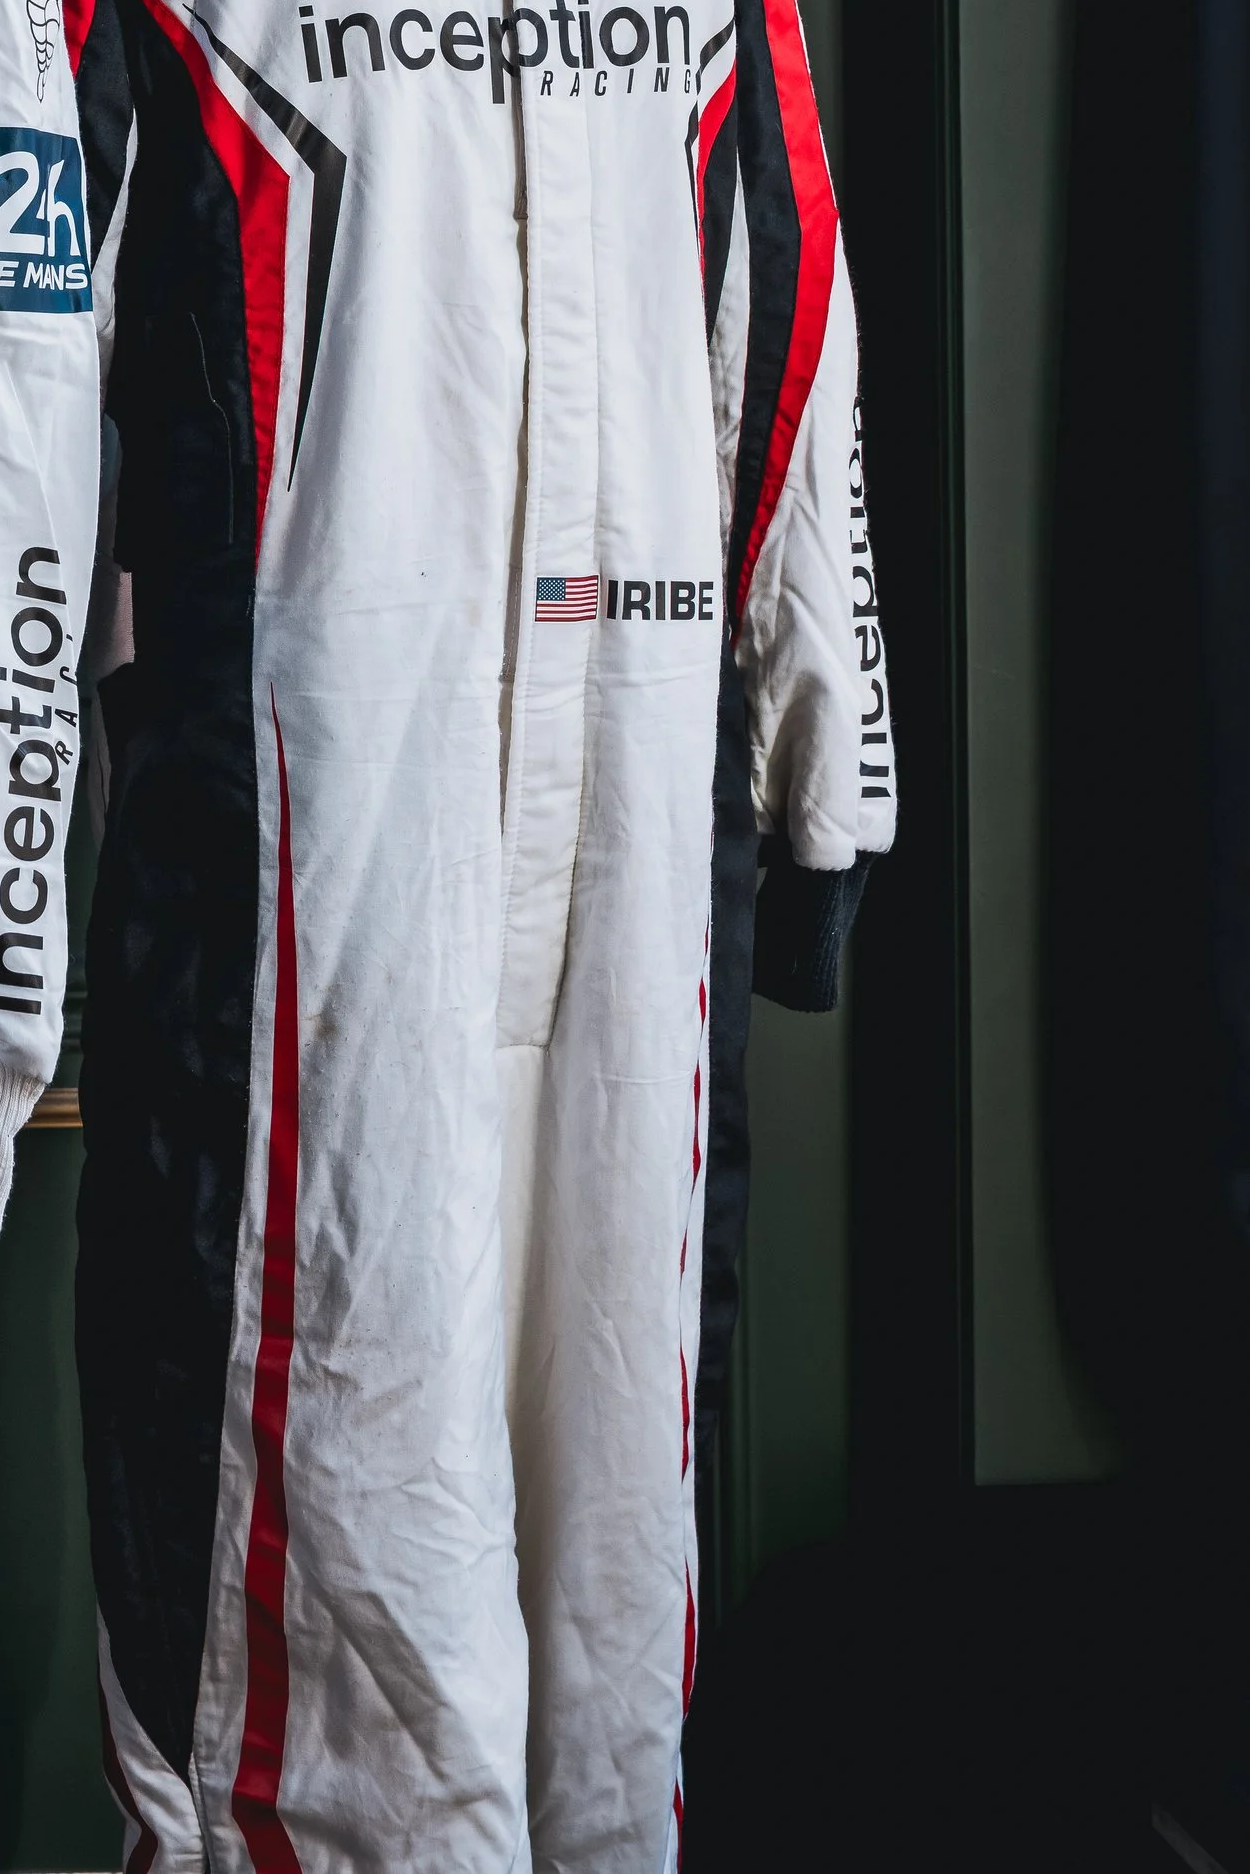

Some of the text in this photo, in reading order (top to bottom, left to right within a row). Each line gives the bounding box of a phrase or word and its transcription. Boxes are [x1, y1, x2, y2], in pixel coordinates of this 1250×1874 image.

[540, 67, 694, 96] RACING
[23, 261, 88, 291] MANS
[607, 579, 714, 621] IRIBE
